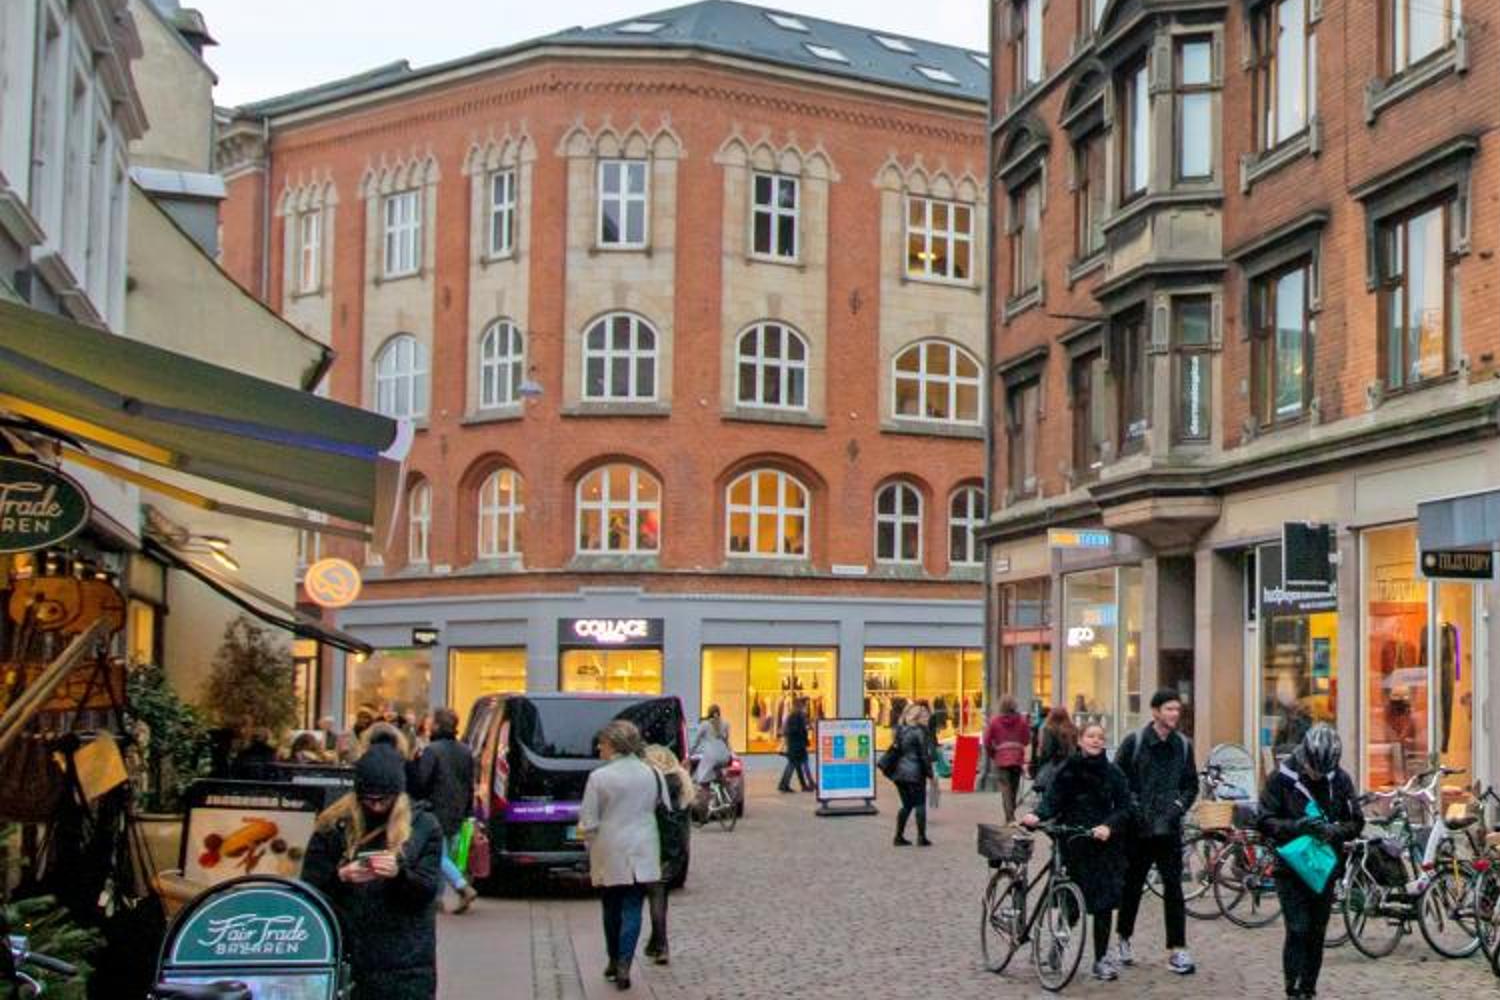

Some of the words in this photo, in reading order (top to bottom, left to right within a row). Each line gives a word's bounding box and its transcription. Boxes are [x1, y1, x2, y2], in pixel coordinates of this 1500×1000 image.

[575, 620, 648, 637] COLLAGE
[197, 913, 257, 946] Fair
[249, 915, 309, 948] Trade
